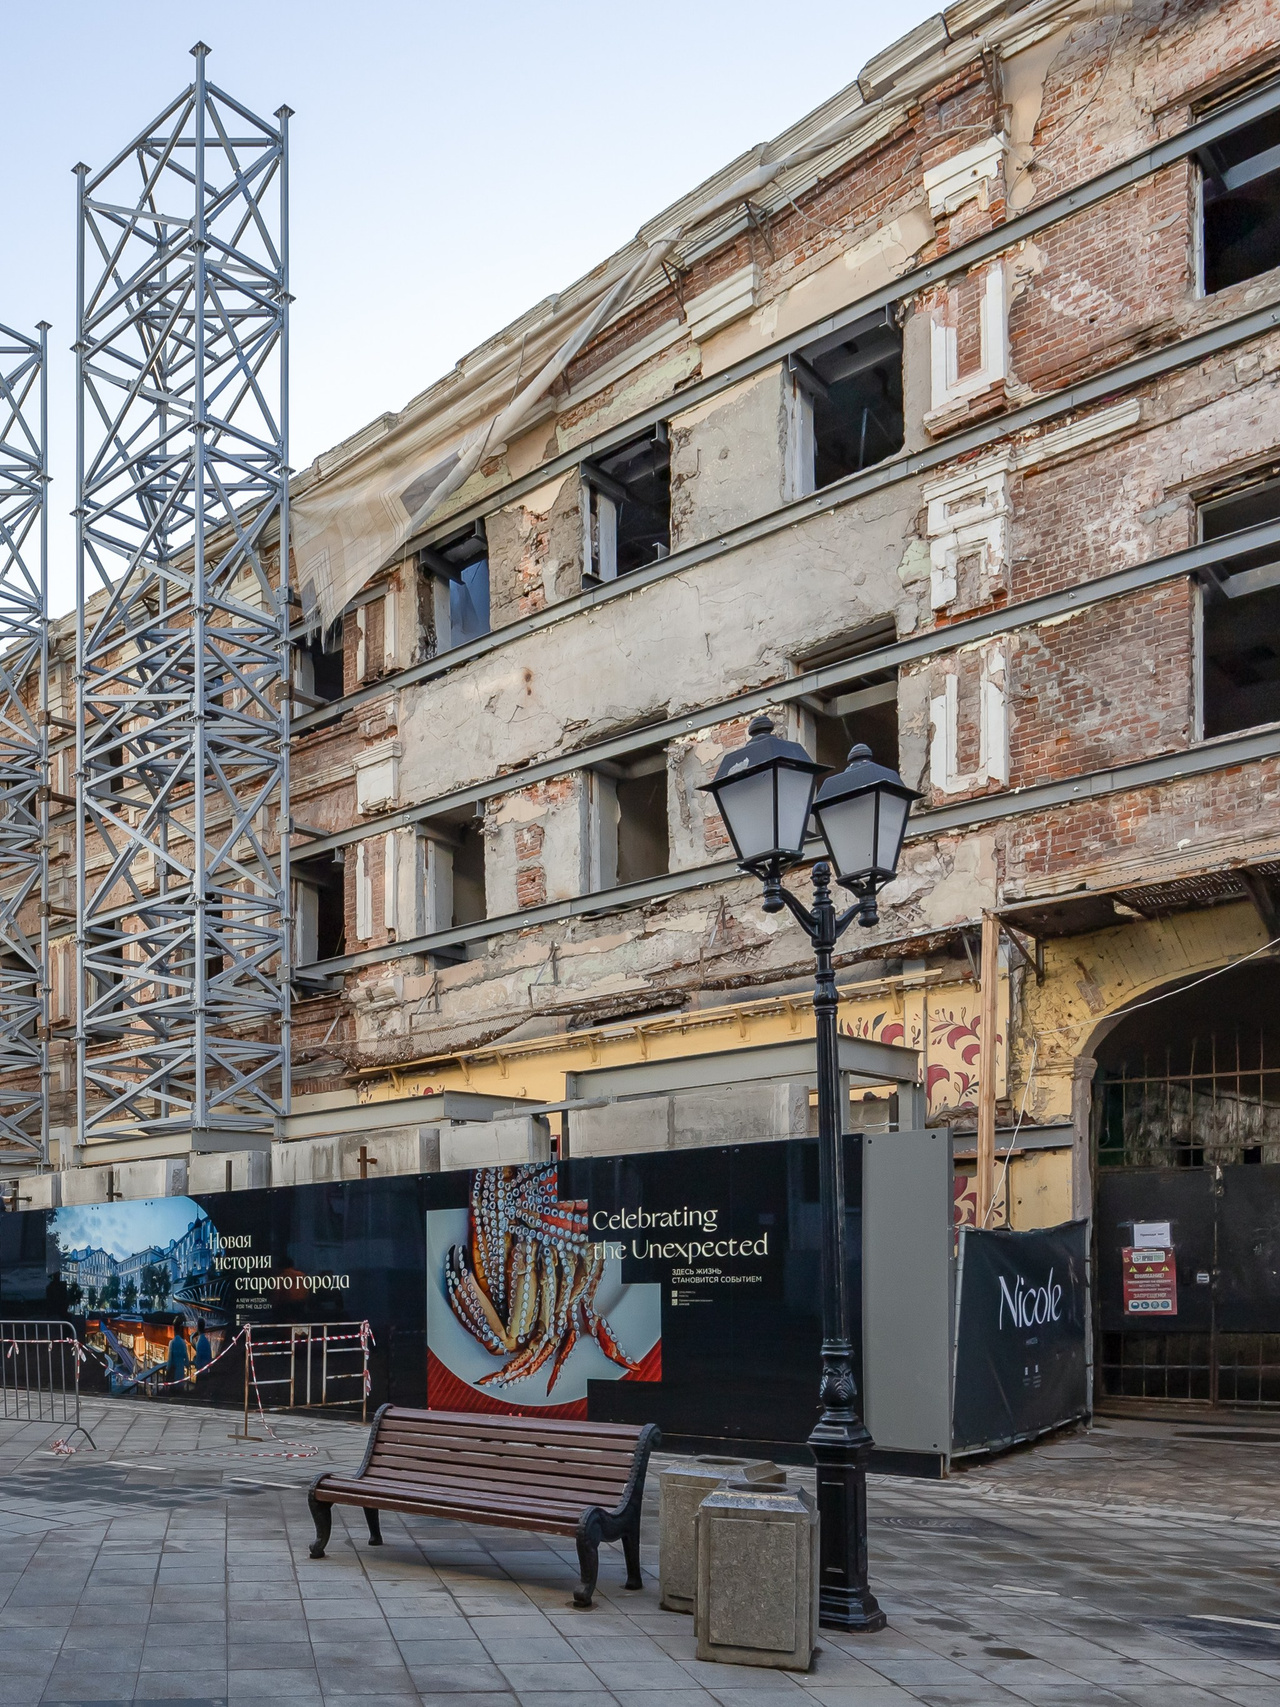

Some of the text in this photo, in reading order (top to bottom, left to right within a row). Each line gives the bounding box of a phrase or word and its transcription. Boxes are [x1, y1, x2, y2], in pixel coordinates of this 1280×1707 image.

[592, 1206, 718, 1232] Celebrating
[209, 1232, 252, 1250] Новая
[593, 1232, 768, 1264] the Unexpected
[215, 1255, 272, 1273] история
[672, 1268, 694, 1276] ЗДЕСЬ
[235, 1274, 350, 1294] старого города
[672, 1275, 762, 1284] СТАНОВИТСЯ СОБЫТИЕМ
[999, 1267, 1061, 1330] Nicole
